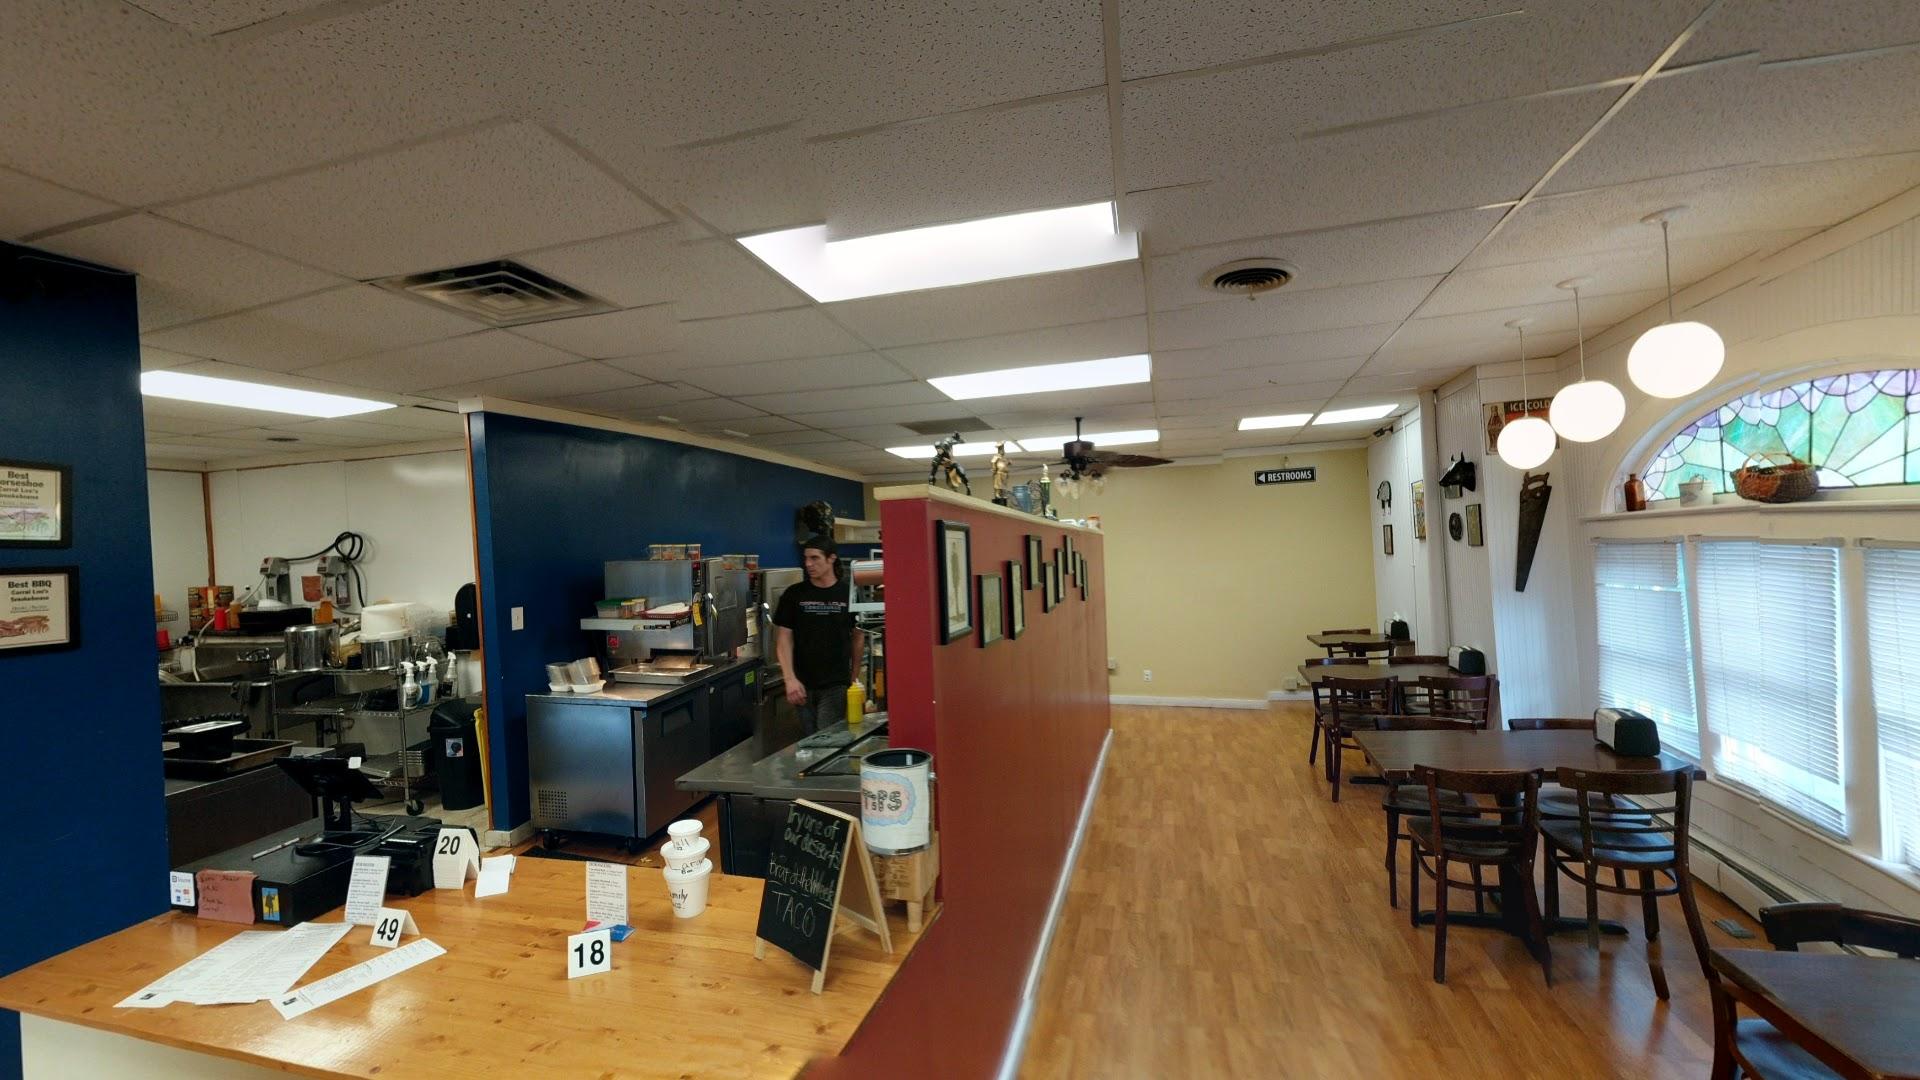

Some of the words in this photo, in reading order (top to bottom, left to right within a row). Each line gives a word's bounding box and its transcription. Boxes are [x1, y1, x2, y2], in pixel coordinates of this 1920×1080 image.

[1510, 402, 1524, 412] ICE
[1527, 400, 1550, 410] COLD
[8, 471, 28, 479] Best
[1267, 470, 1312, 482] RESTROOMS
[0, 479, 44, 488] orseshoe
[32, 580, 52, 588] BBQ
[823, 820, 840, 841] of
[438, 836, 461, 855] 20
[771, 891, 817, 937] TACO
[377, 918, 399, 941] 49
[574, 940, 605, 968] 18
